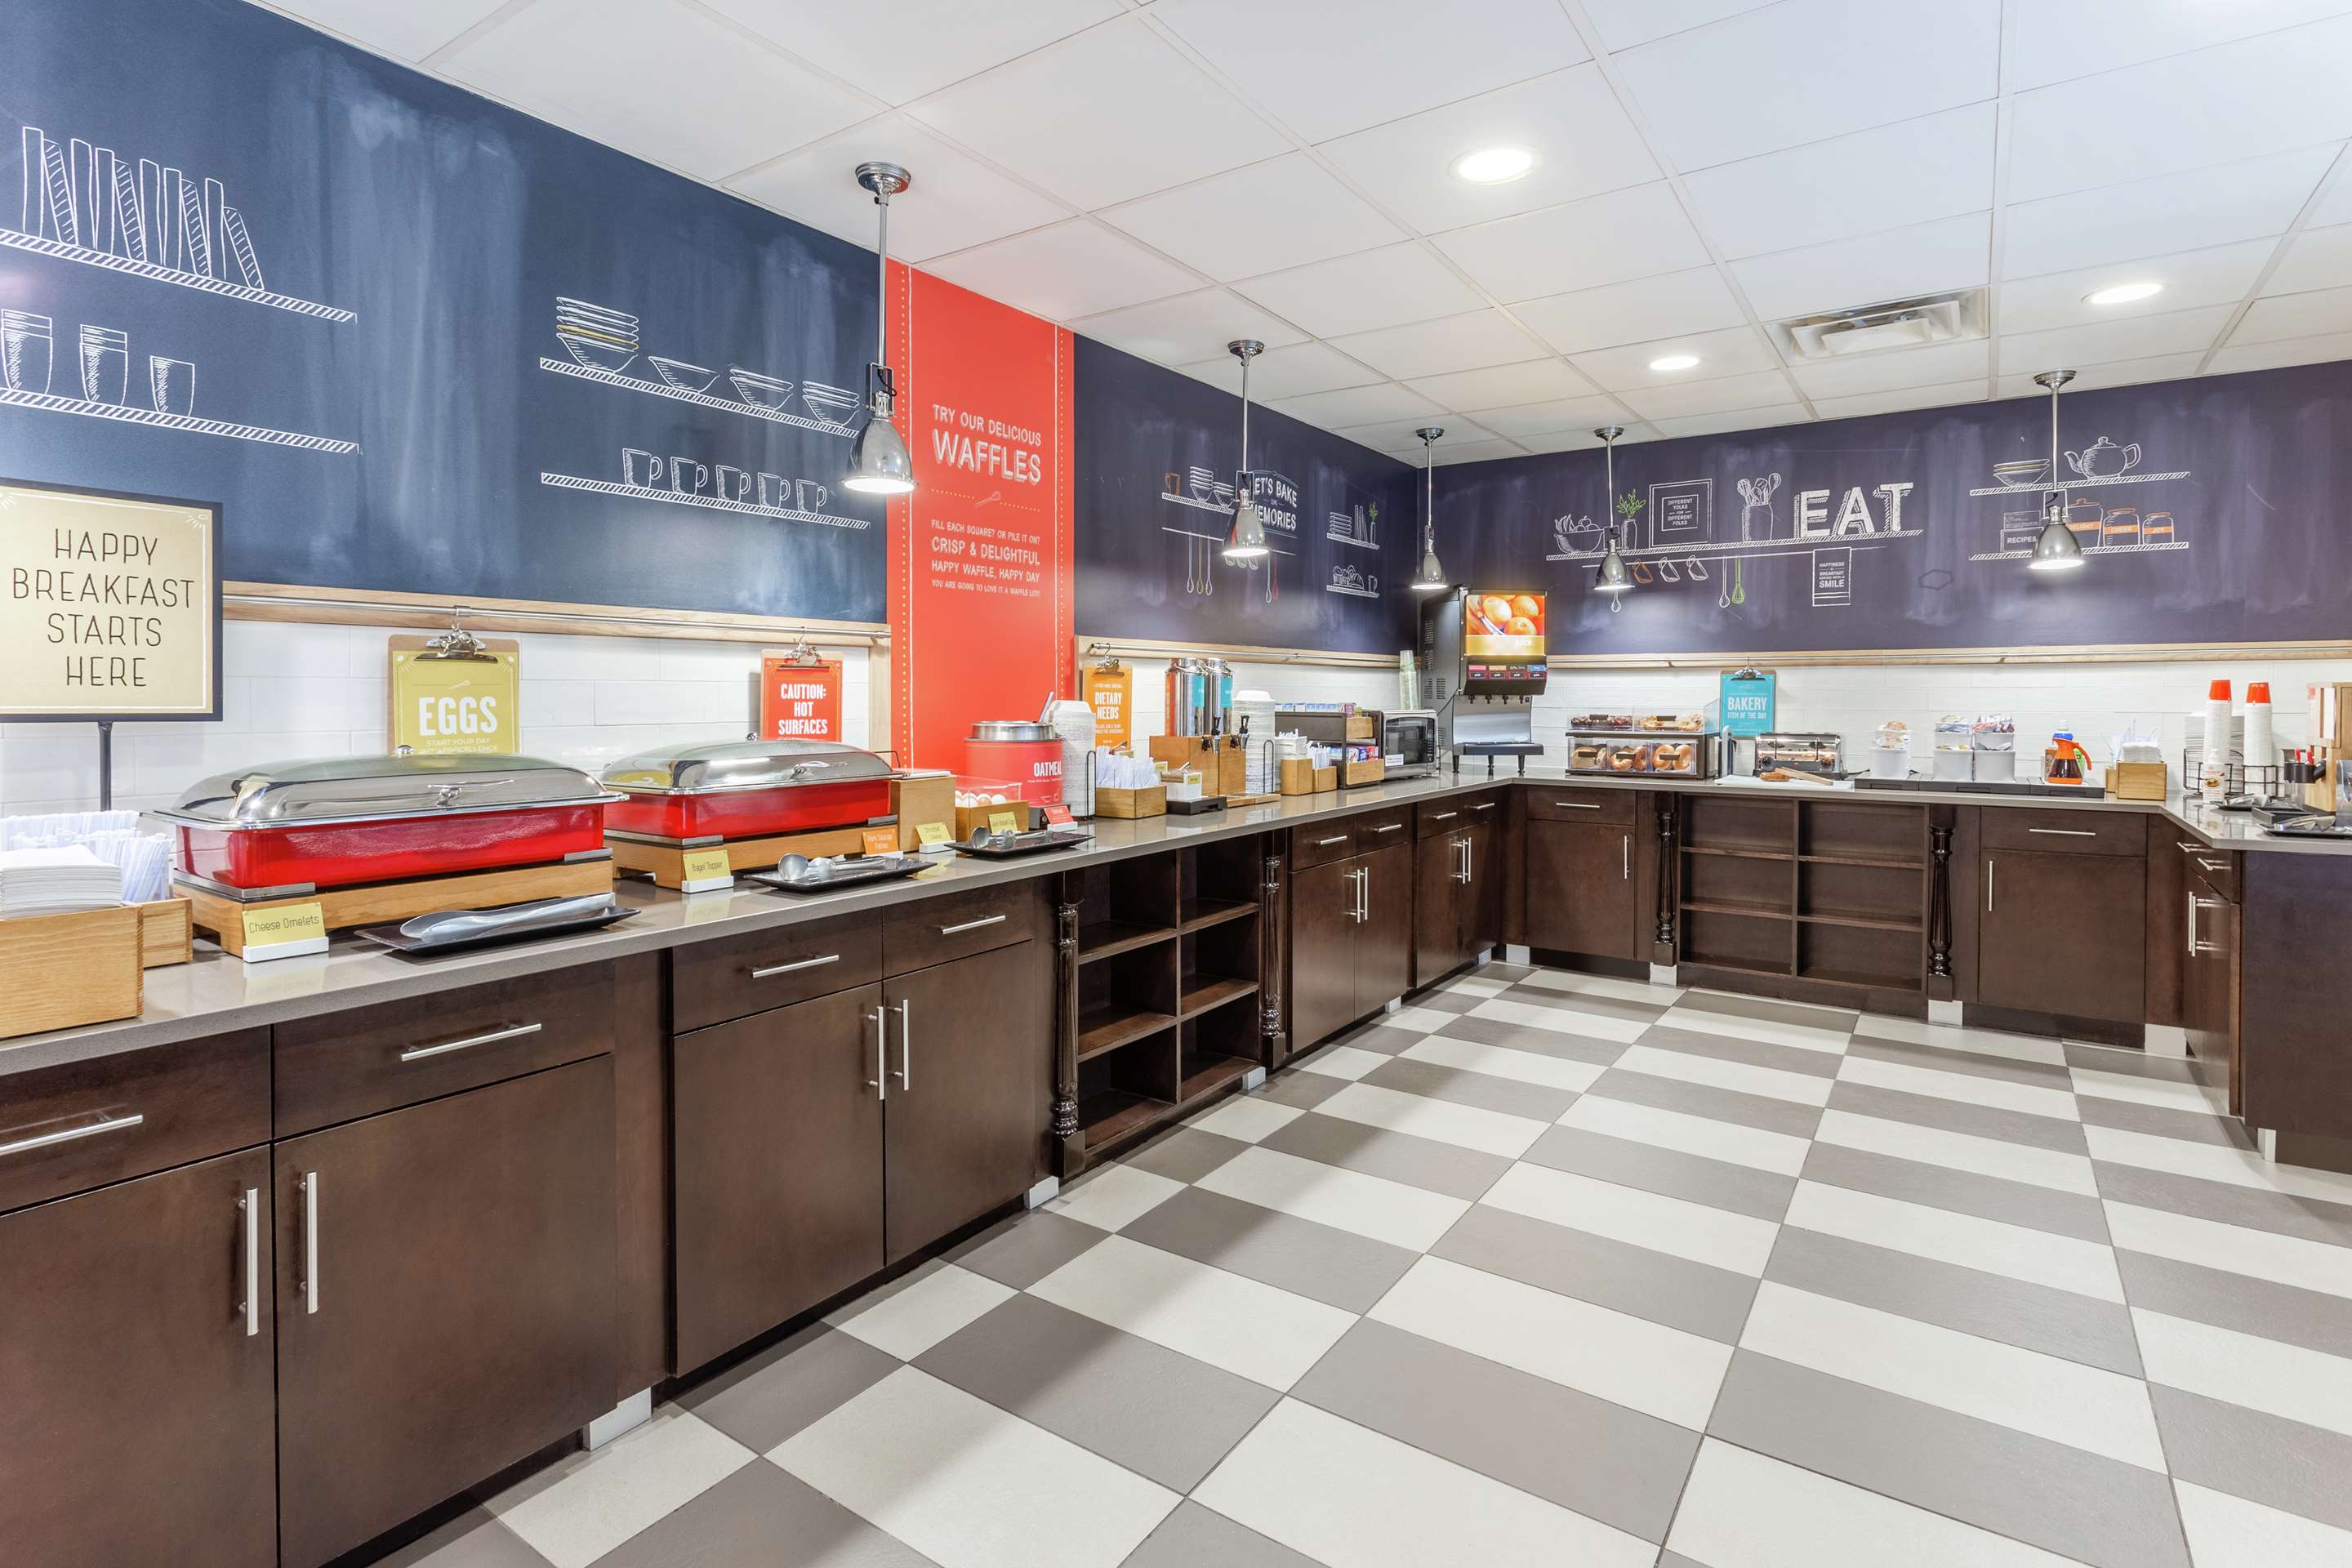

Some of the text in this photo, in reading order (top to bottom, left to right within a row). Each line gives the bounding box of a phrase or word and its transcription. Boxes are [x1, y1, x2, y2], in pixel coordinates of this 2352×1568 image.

[933, 404, 1041, 447] TRY OUR DELICIOUS
[933, 429, 1041, 486] WAFFLES
[1254, 477, 1297, 509] ET'S BAKE
[1793, 482, 1913, 539] EAT
[931, 519, 945, 530] FILL
[947, 522, 964, 533] EACH
[967, 525, 996, 537] SQUARE?
[997, 529, 1006, 539] OR
[1008, 532, 1020, 542] PILE
[2007, 536, 2037, 544] RECIPES
[55, 528, 158, 566] HAPPY
[932, 536, 1040, 567] CRISP & DELIGHTFUL
[931, 560, 1040, 583] HAPPY WAFFLE, HAPPY DAY
[12, 568, 196, 608] BREAKFAST
[931, 579, 943, 588] YOU
[945, 581, 956, 589] ARE
[1819, 579, 1845, 589] SMILE
[47, 612, 163, 647] STARTS
[66, 656, 147, 687] HERE
[780, 683, 827, 700] CAUTION:
[1094, 692, 1123, 706] DIETARY
[794, 701, 814, 717] HOT
[1097, 706, 1120, 719] NEEDS
[1727, 697, 1768, 711] BAKERY
[418, 696, 497, 737] EGGS
[1740, 711, 1746, 719] OF
[778, 719, 828, 735] SURFACES
[692, 862, 724, 874] Bagel Topper
[248, 915, 320, 933] Cheese Omelets
